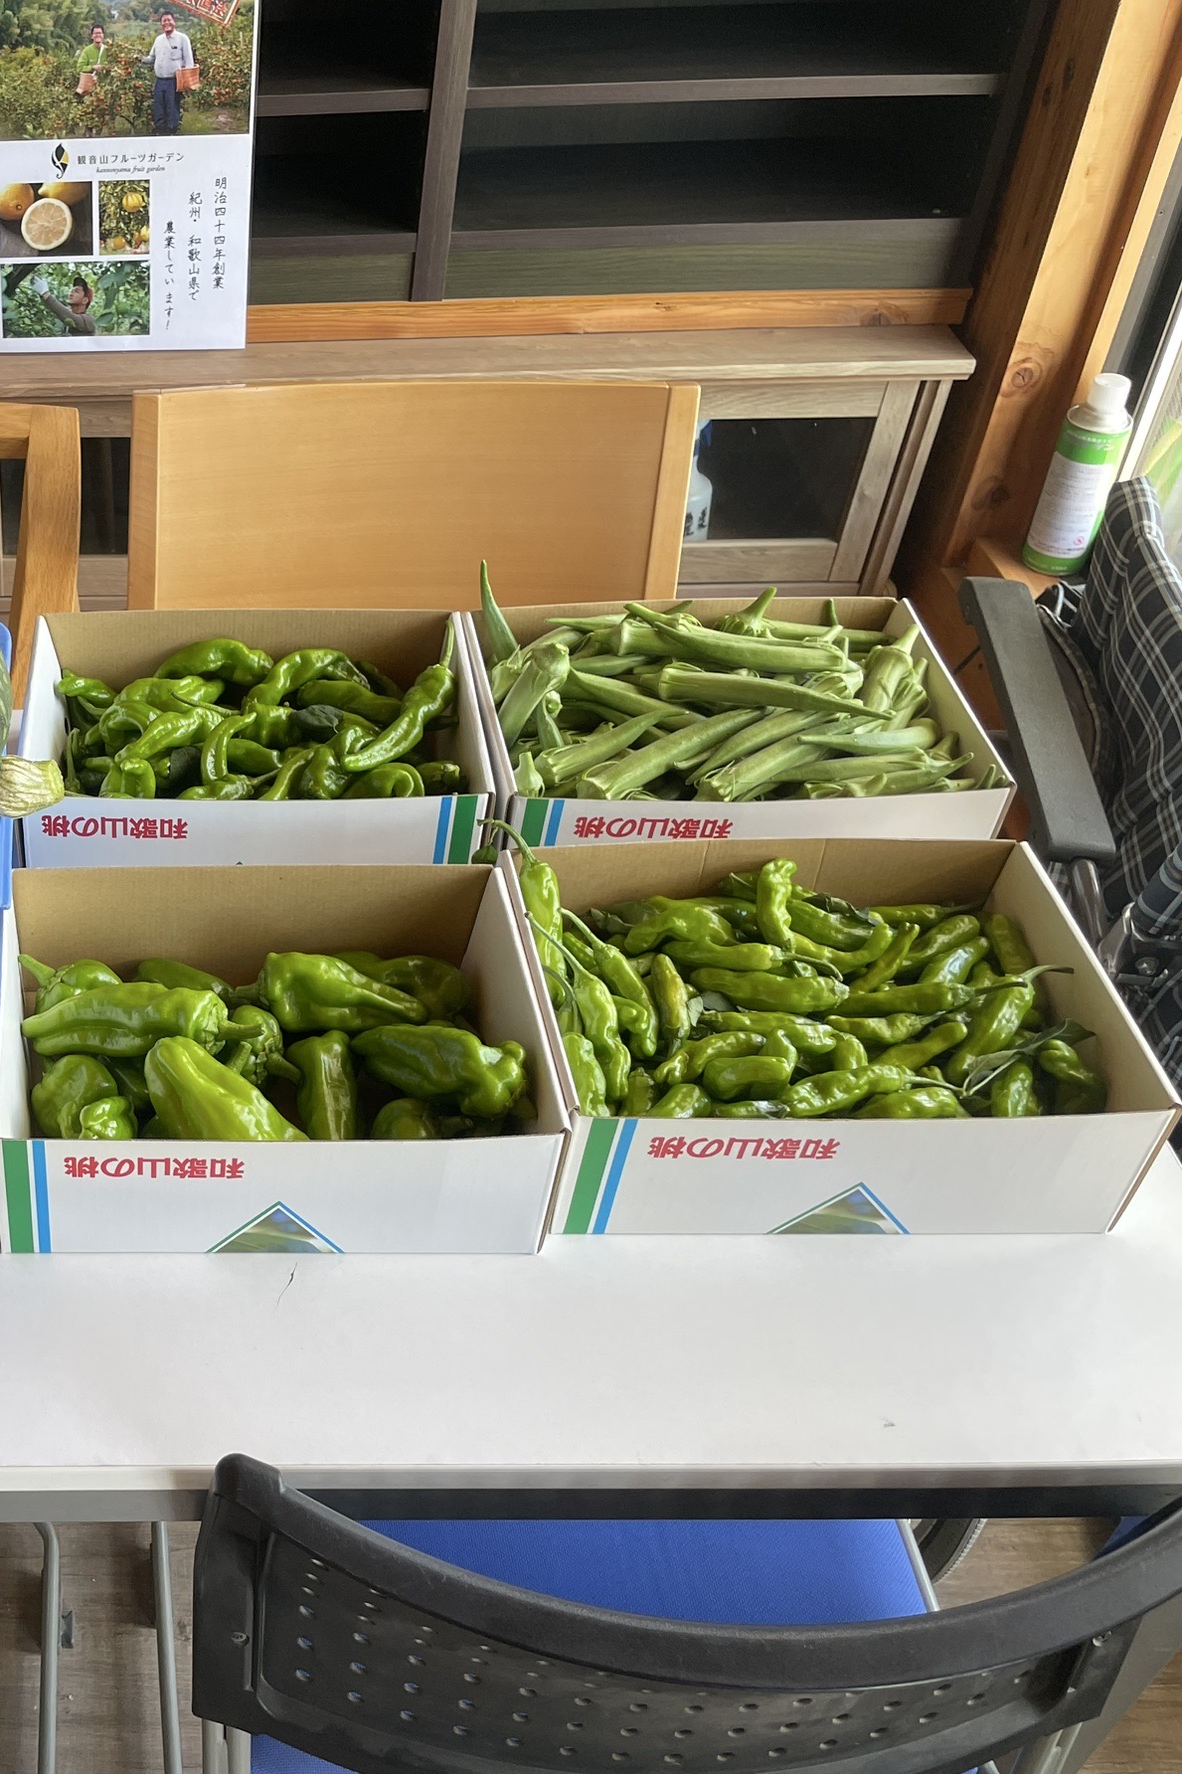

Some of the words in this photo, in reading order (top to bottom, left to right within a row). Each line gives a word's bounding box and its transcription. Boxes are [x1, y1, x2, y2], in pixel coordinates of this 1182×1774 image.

[77, 152, 184, 165] 観音山フルーツガーデン
[131, 166, 145, 174] fruit
[146, 165, 166, 173] garden
[212, 177, 228, 290] 明治四十四年創業
[42, 815, 188, 839] 和歌山の桃
[574, 817, 733, 839] 和歌山の桃
[649, 1136, 840, 1160] 和歌山の桃
[64, 1156, 245, 1179] 和歌山の桃
